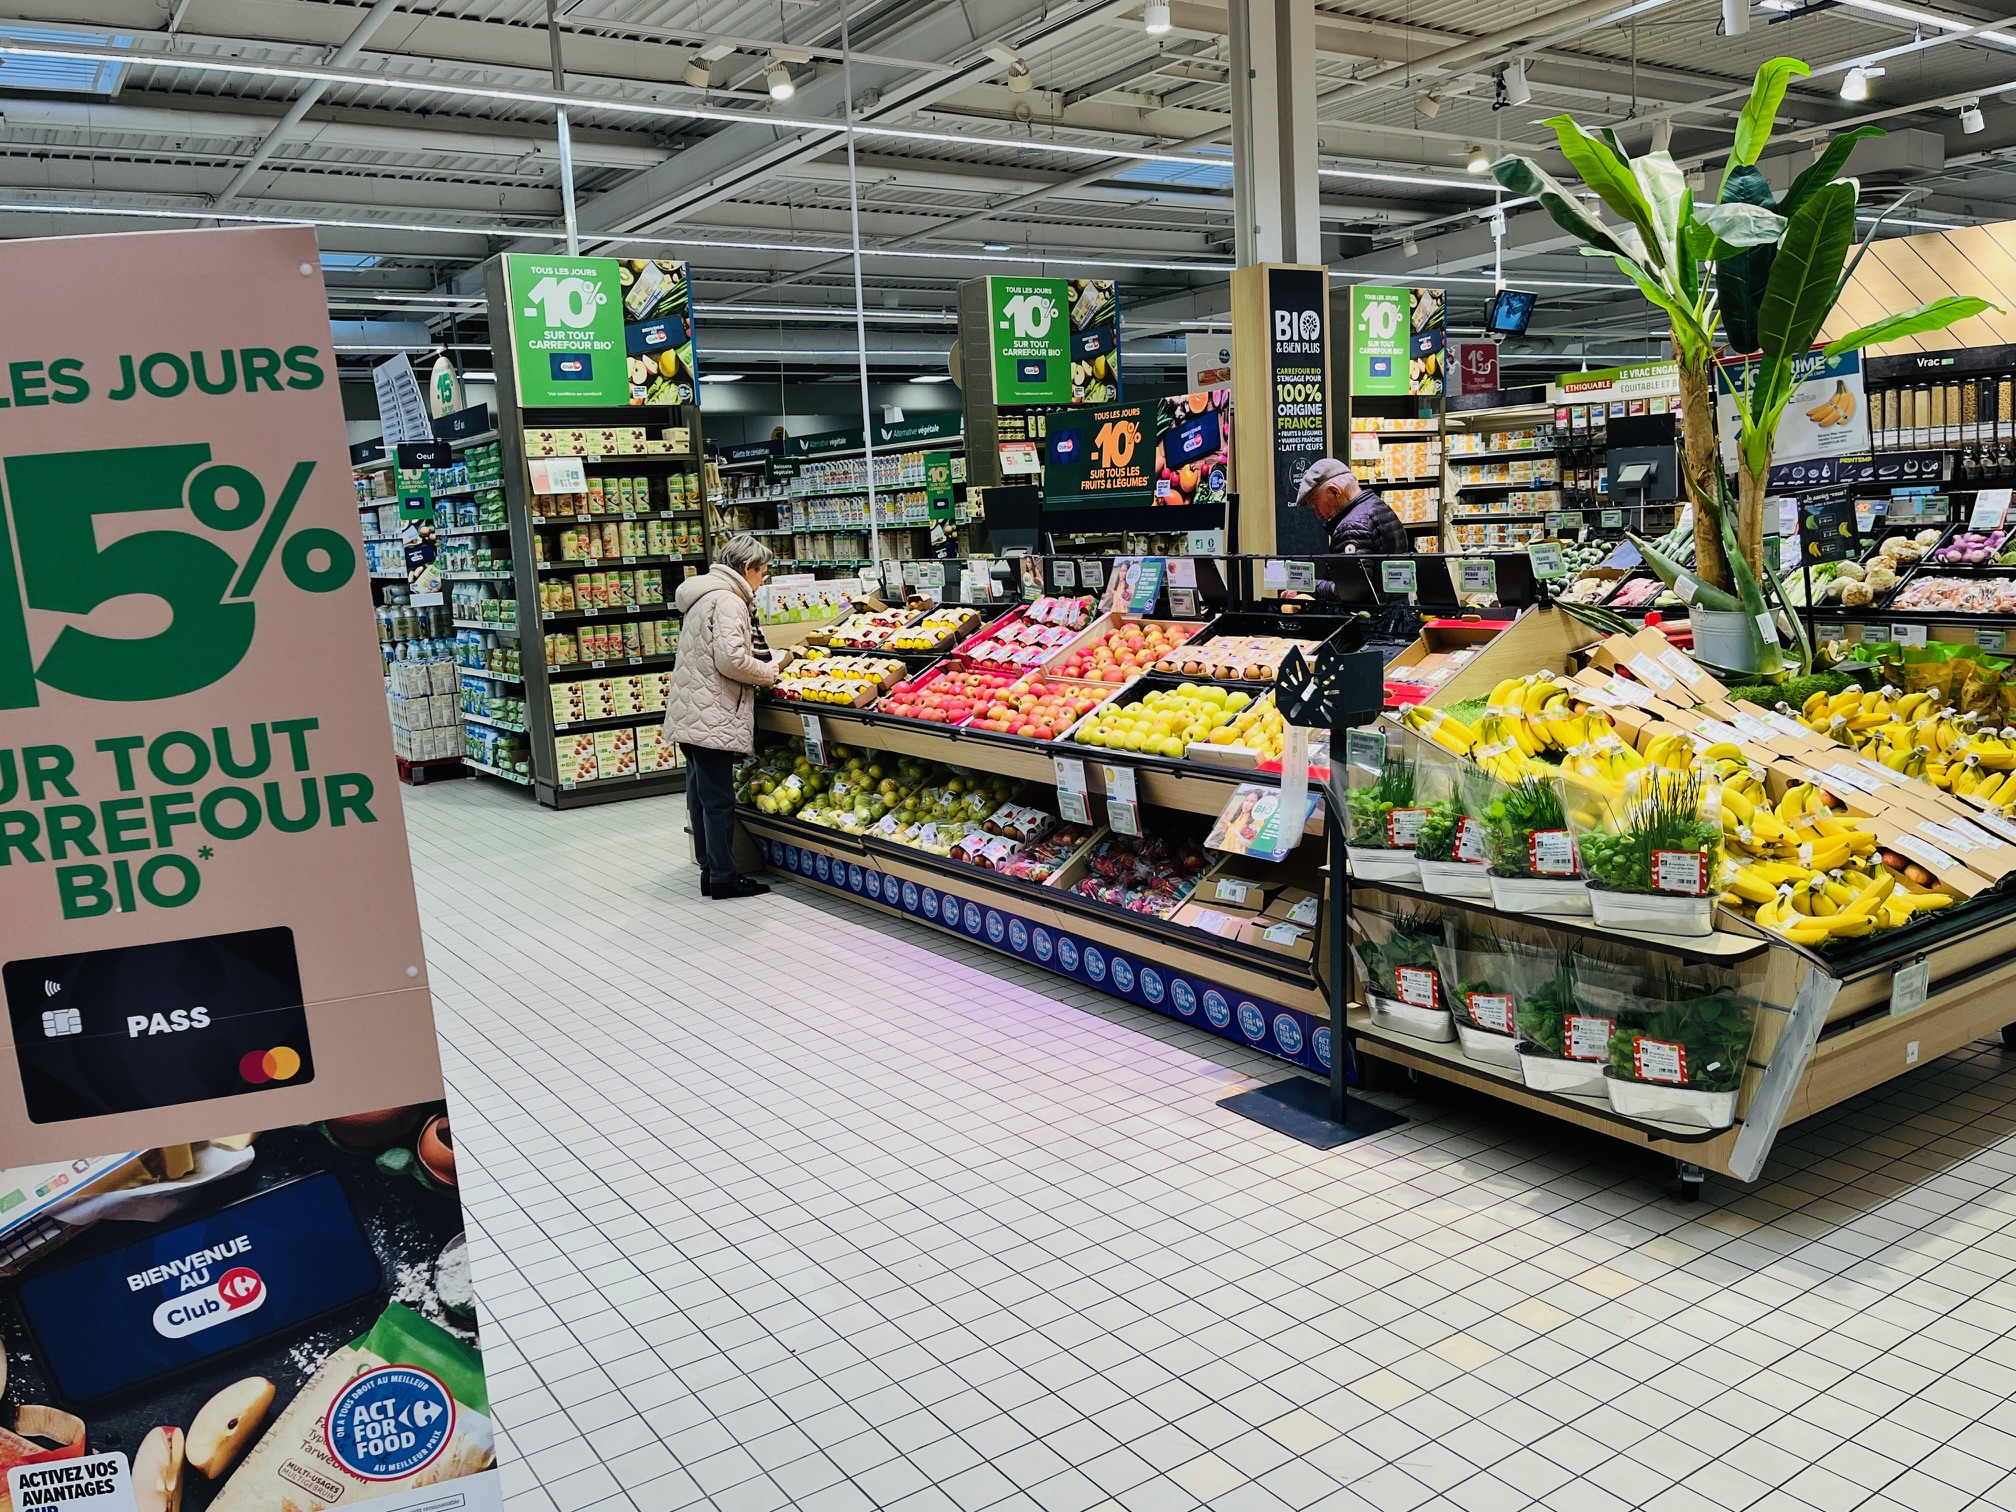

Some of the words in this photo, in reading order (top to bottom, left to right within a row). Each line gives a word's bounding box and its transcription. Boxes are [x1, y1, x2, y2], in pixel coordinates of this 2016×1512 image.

[524, 277, 607, 328] -10%
[1000, 295, 1059, 338] -10%
[1275, 310, 1320, 340] BIO
[1358, 302, 1403, 339] -10%
[529, 340, 592, 350] CARREFOUR
[544, 331, 564, 340] SUR
[567, 331, 595, 340] TOUT
[1276, 342, 1282, 353] &
[1302, 343, 1320, 353] PLUS
[1620, 371, 1628, 379] LE
[1630, 368, 1650, 378] VRAC
[1916, 357, 1940, 367] Vrac
[0, 357, 90, 408] ES
[108, 345, 325, 400] JOURS
[1565, 380, 1611, 393] ETHIQUABLE
[1621, 381, 1659, 392] EQUITABLE
[1662, 380, 1669, 388] ET
[1277, 384, 1322, 403] 100%
[1094, 412, 1109, 420] TOUS
[1111, 410, 1120, 418] LES
[1121, 408, 1140, 417] JOURS
[1278, 404, 1322, 416] ORIGINE
[1278, 417, 1322, 429] FRANCE
[918, 424, 939, 435] végétale
[1091, 420, 1142, 468] -10%
[1282, 444, 1296, 452] LAIT
[1306, 442, 1323, 450] ŒUFS
[1081, 480, 1105, 490] FRUITS
[1106, 479, 1111, 488] &
[1090, 469, 1104, 479] SUR
[1106, 468, 1125, 478] TOUS
[1127, 466, 1140, 476] LES
[95, 717, 320, 792] TOUT
[1254, 805, 1273, 814] BIO
[127, 1006, 211, 1038] PASS
[1279, 1023, 1290, 1031] ACT
[126, 1234, 252, 1292] BIENVENUE
[180, 1266, 210, 1292] AU
[166, 1297, 221, 1327] Club
[339, 1399, 355, 1417] TOUS
[352, 1380, 375, 1399] DROIT
[378, 1375, 388, 1385] AU
[391, 1375, 429, 1391] MEILLEUR
[353, 1398, 396, 1426] ACT
[354, 1419, 397, 1444] FOR
[356, 1431, 416, 1460] FOOD
[373, 1463, 385, 1472] AU
[388, 1450, 429, 1471] MEILLEUR
[426, 1429, 442, 1451] PRIX
[19, 1464, 84, 1490] ACTIVEZ
[84, 1460, 118, 1478] VOS
[282, 1468, 335, 1501] MULTIGEBRUIK
[287, 1461, 340, 1494] MULTI-USAGES
[22, 1478, 115, 1507] AVANTAGES
